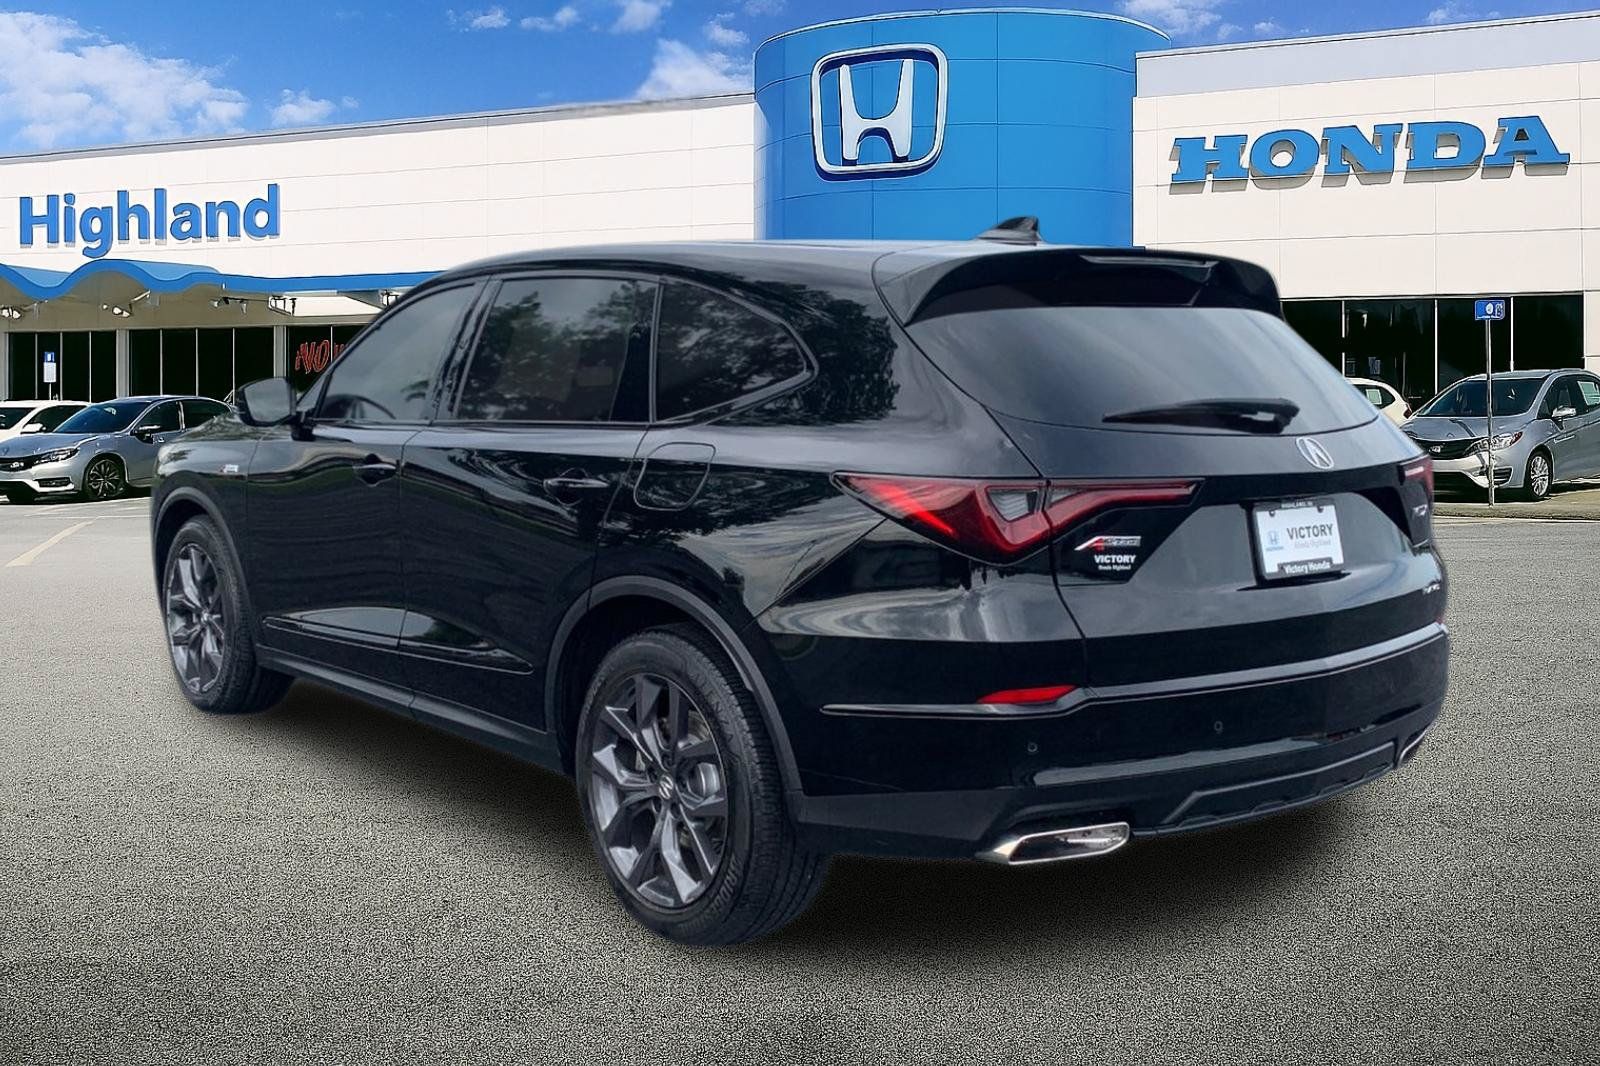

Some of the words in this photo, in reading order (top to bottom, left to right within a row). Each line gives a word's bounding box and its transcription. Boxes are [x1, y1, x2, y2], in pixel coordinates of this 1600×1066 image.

[1171, 115, 1570, 186] HONDA
[19, 183, 280, 258] Highland
[1286, 523, 1334, 540] VICTORY
[1094, 554, 1136, 564] VICTORY
